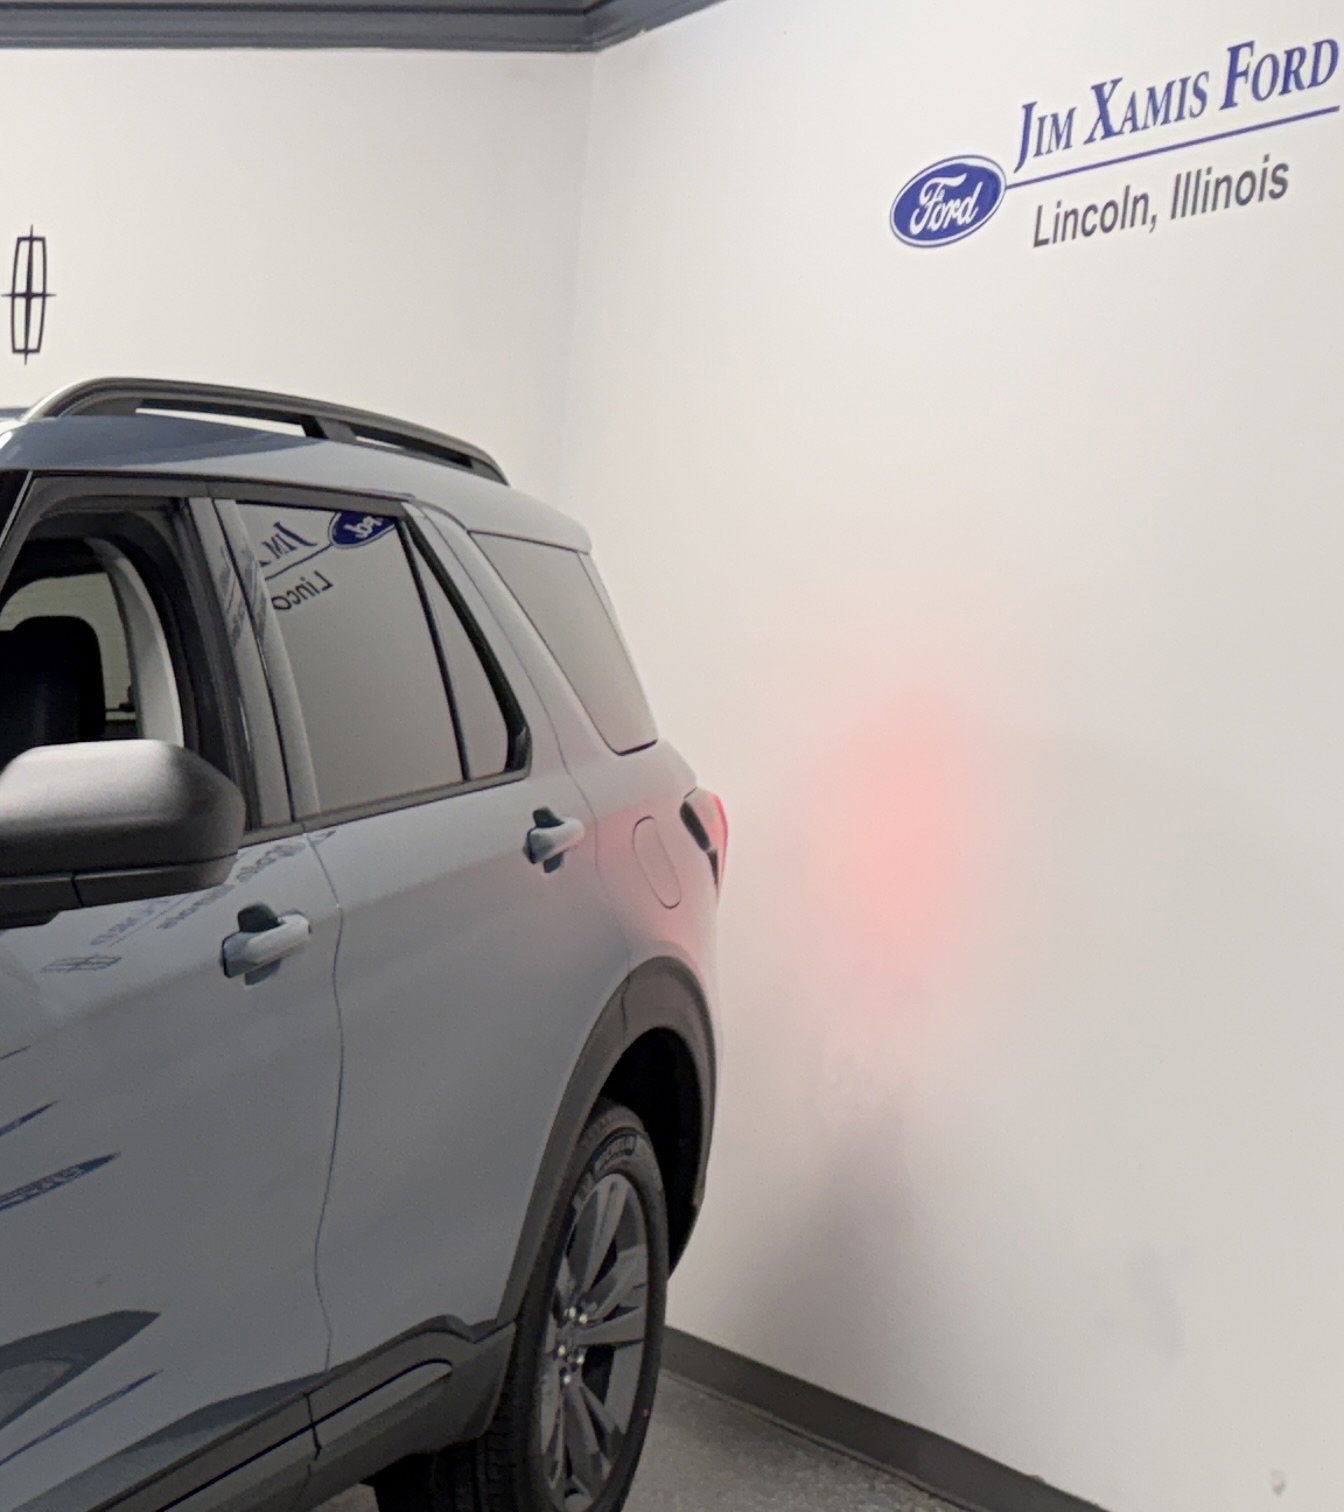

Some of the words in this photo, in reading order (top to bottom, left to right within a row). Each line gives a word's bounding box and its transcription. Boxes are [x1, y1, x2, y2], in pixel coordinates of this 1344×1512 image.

[1013, 101, 1077, 173] JIM
[1084, 70, 1210, 145] XAMIS
[1219, 38, 1340, 111] FORD
[909, 171, 979, 234] Ford
[1033, 184, 1158, 247] Lincoln,
[1170, 154, 1290, 220] Illinois
